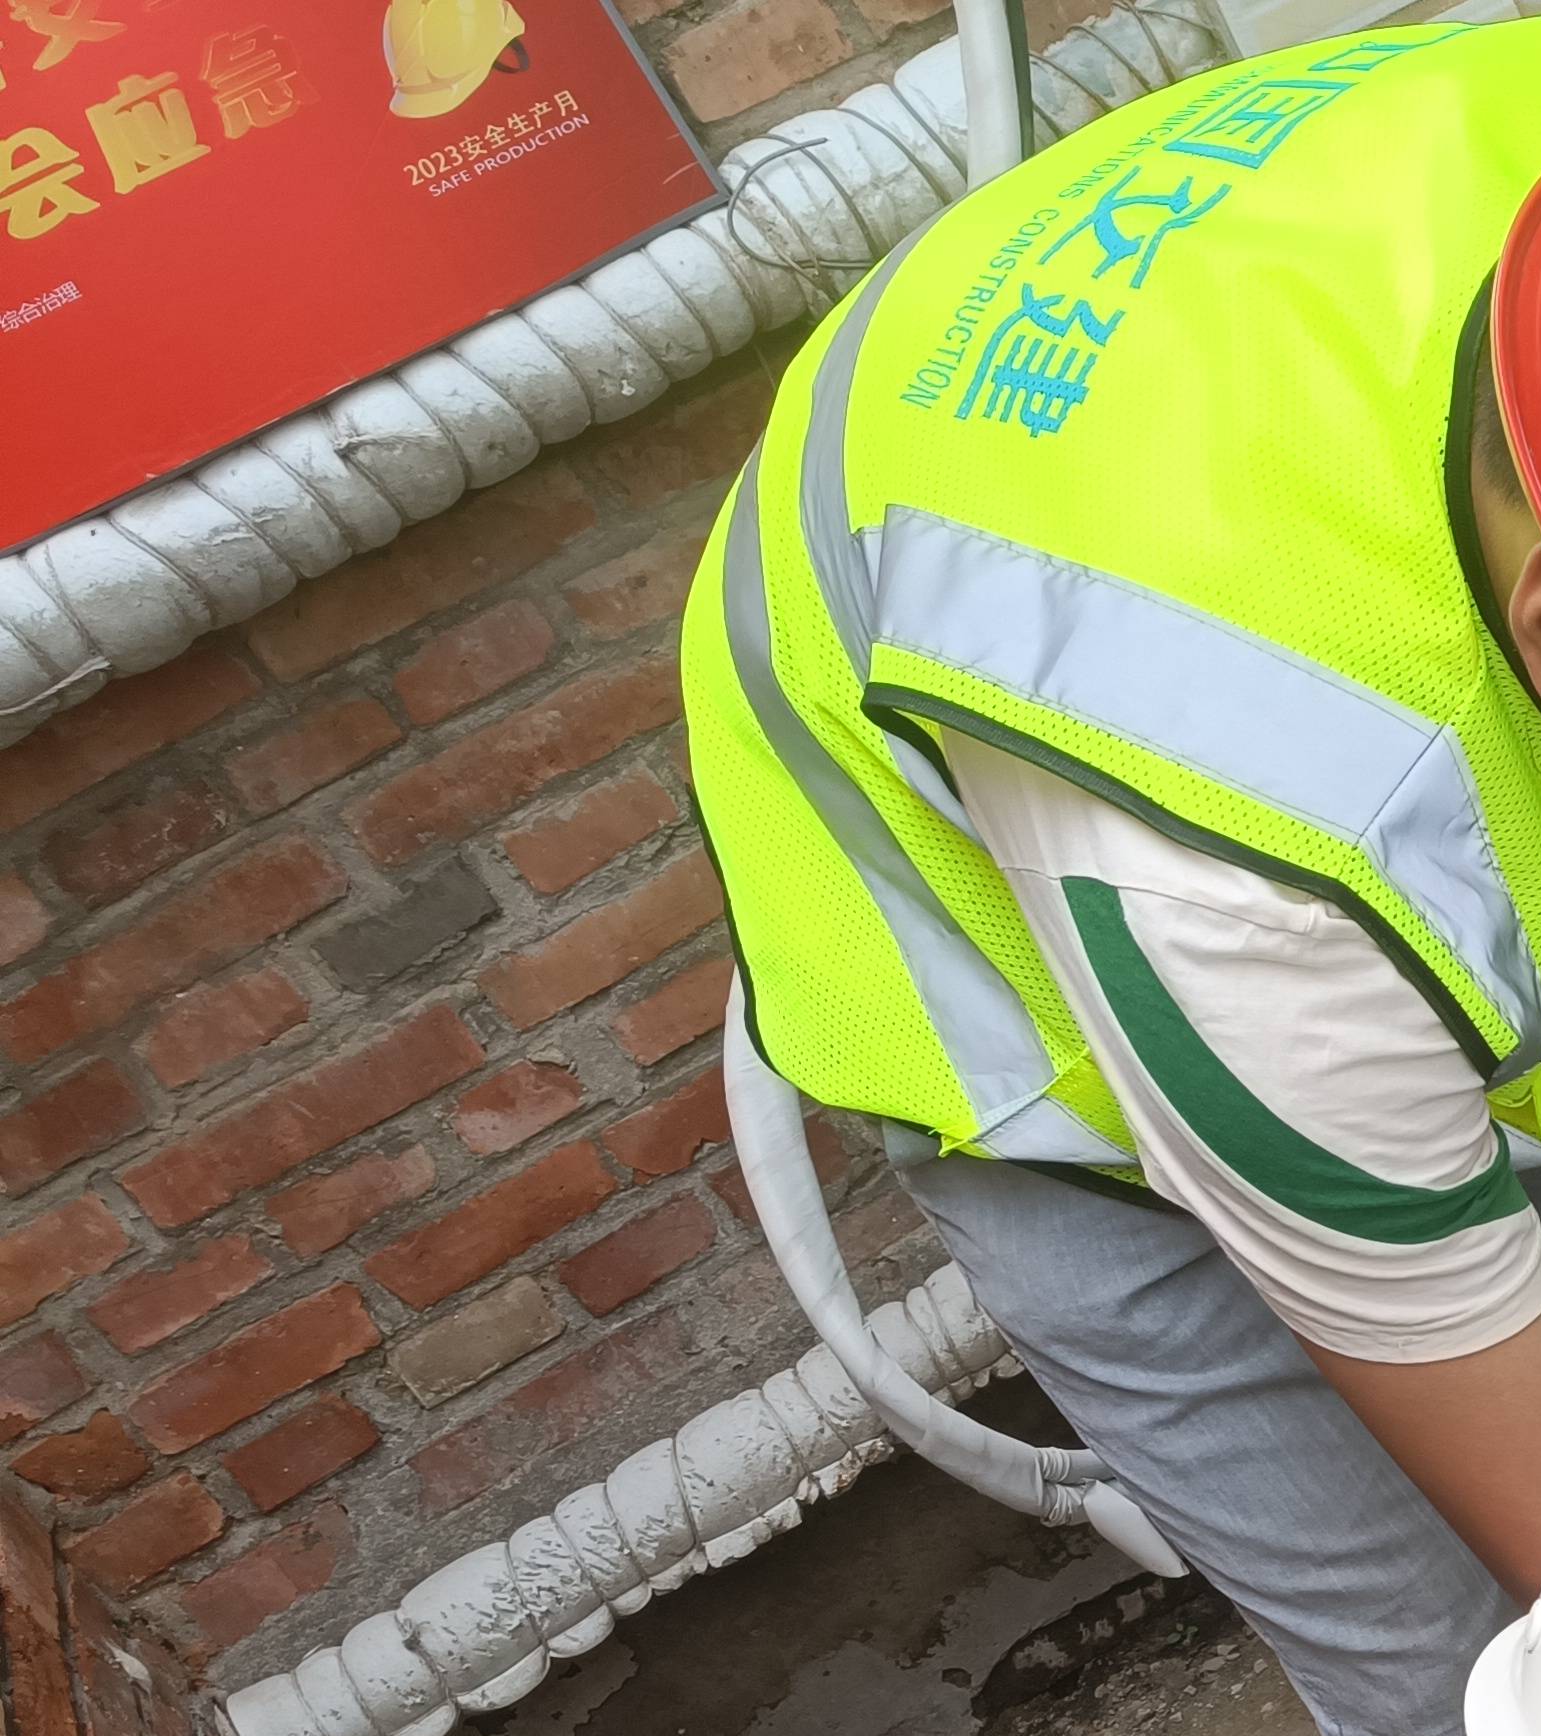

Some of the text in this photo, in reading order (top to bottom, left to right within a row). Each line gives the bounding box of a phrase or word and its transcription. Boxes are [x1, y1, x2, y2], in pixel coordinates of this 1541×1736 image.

[403, 90, 578, 186] 2023安全生产月
[428, 114, 590, 197] SAFE PRODUCTION
[900, 208, 1060, 409] CONSTRUCTION
